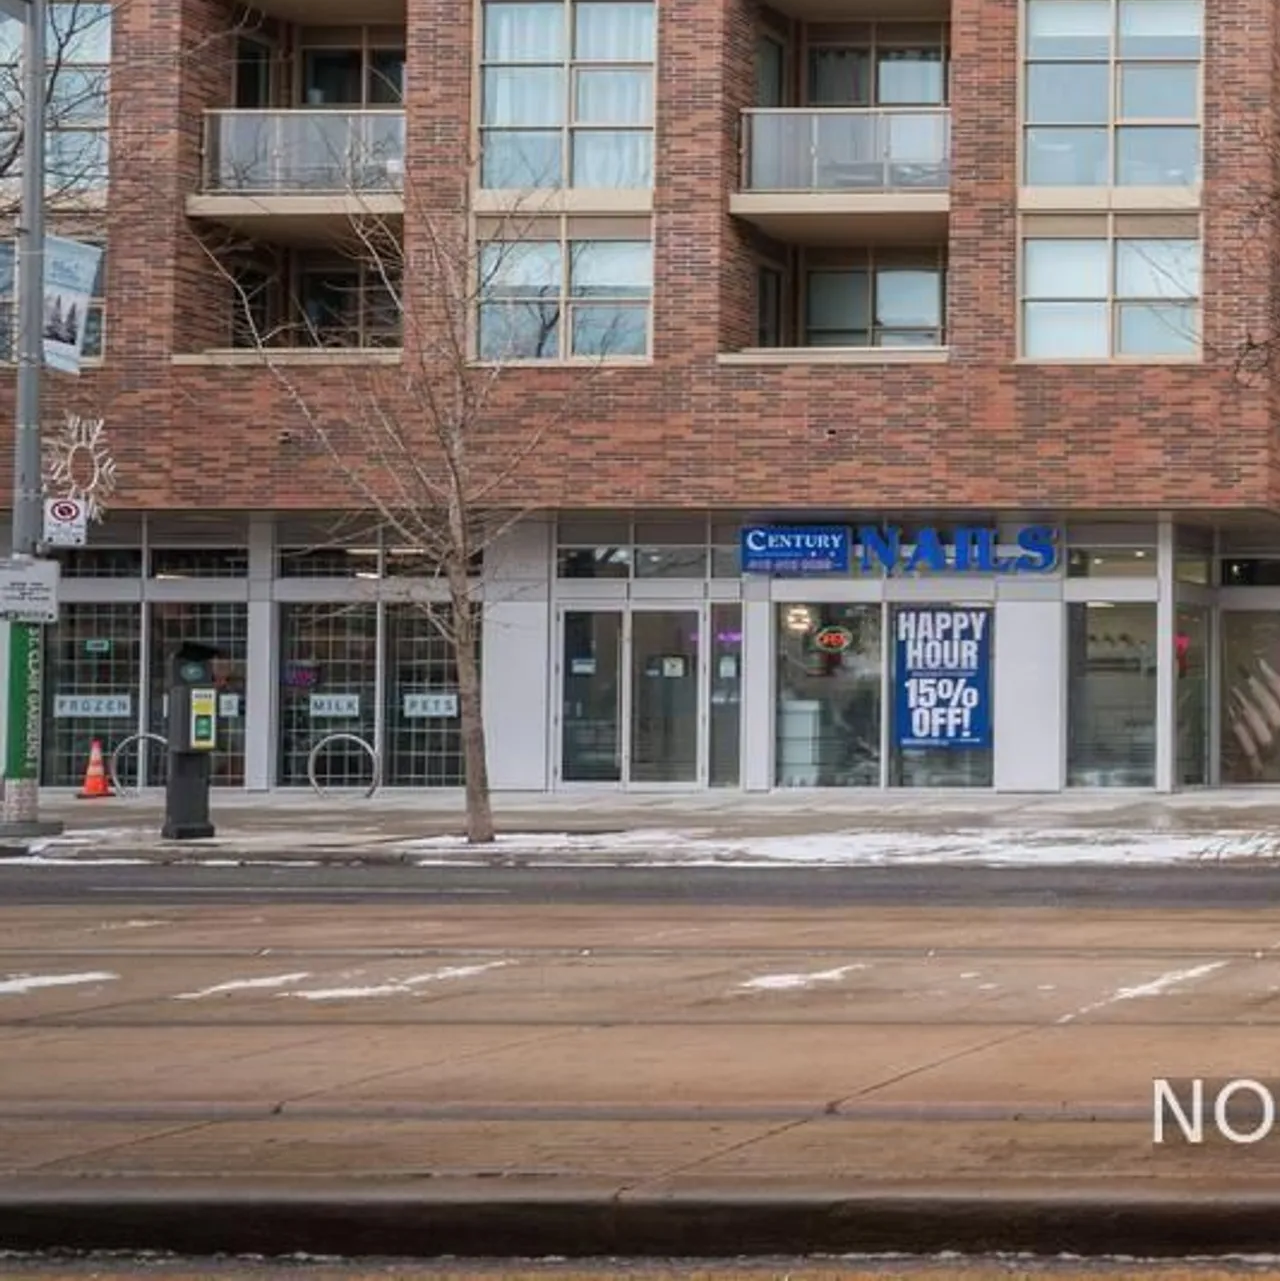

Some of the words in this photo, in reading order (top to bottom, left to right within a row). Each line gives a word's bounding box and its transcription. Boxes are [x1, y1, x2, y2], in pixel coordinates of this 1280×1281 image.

[746, 530, 843, 551] CENTURY
[861, 524, 1056, 572] NAILS
[898, 611, 987, 641] HAPPY
[906, 640, 978, 670] HOUR
[58, 698, 127, 712] FROZEN
[312, 700, 356, 712] MILK
[407, 699, 454, 712] PETS
[904, 678, 979, 708] 15%
[911, 708, 971, 738] OFF!
